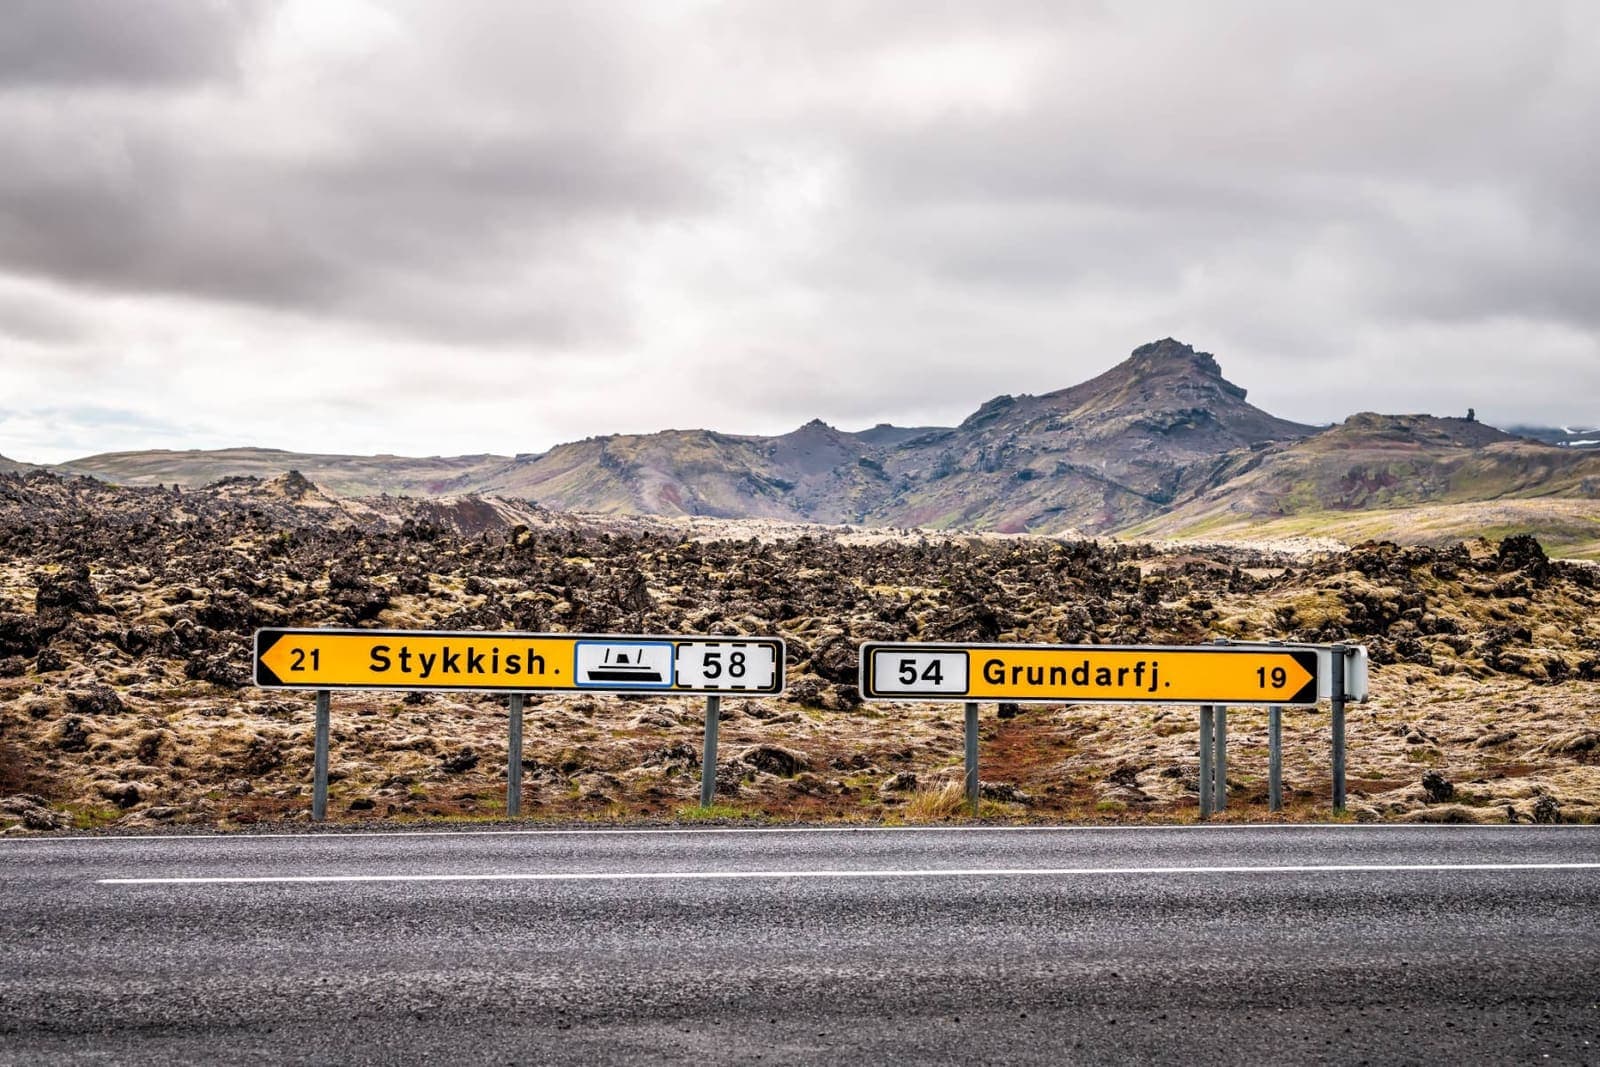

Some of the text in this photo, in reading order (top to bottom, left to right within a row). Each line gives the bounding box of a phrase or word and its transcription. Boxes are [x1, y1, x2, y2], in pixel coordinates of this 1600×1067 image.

[290, 645, 746, 679] 21 Stykkish. 58
[898, 658, 1287, 692] 54 Grundarfj. 19
